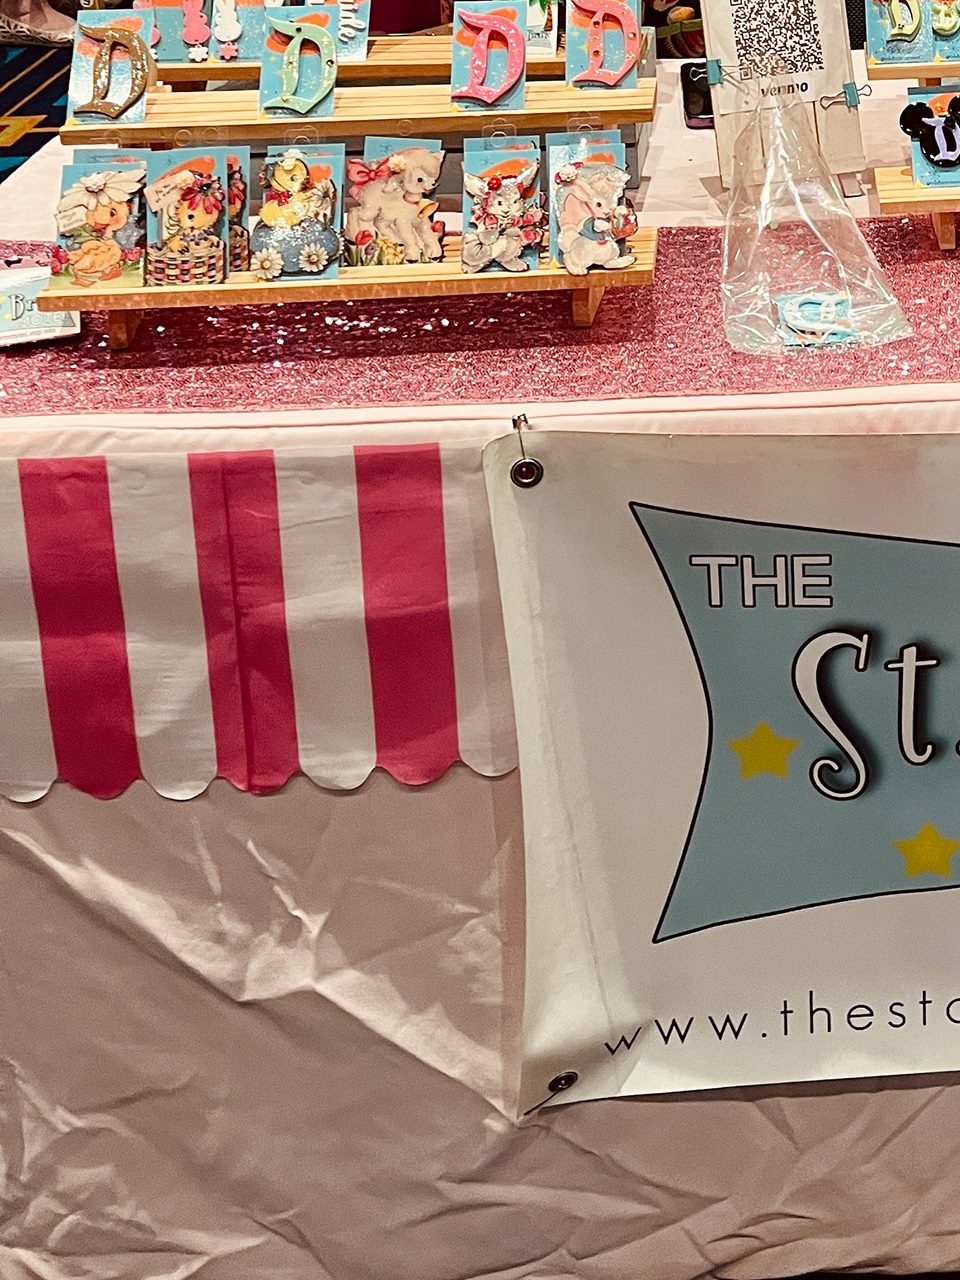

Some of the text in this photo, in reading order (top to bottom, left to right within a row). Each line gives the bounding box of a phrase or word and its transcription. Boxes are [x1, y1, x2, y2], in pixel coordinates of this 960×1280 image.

[263, 16, 338, 114] D
[451, 8, 526, 105] D
[761, 82, 808, 97] venmo
[689, 553, 833, 608] THE
